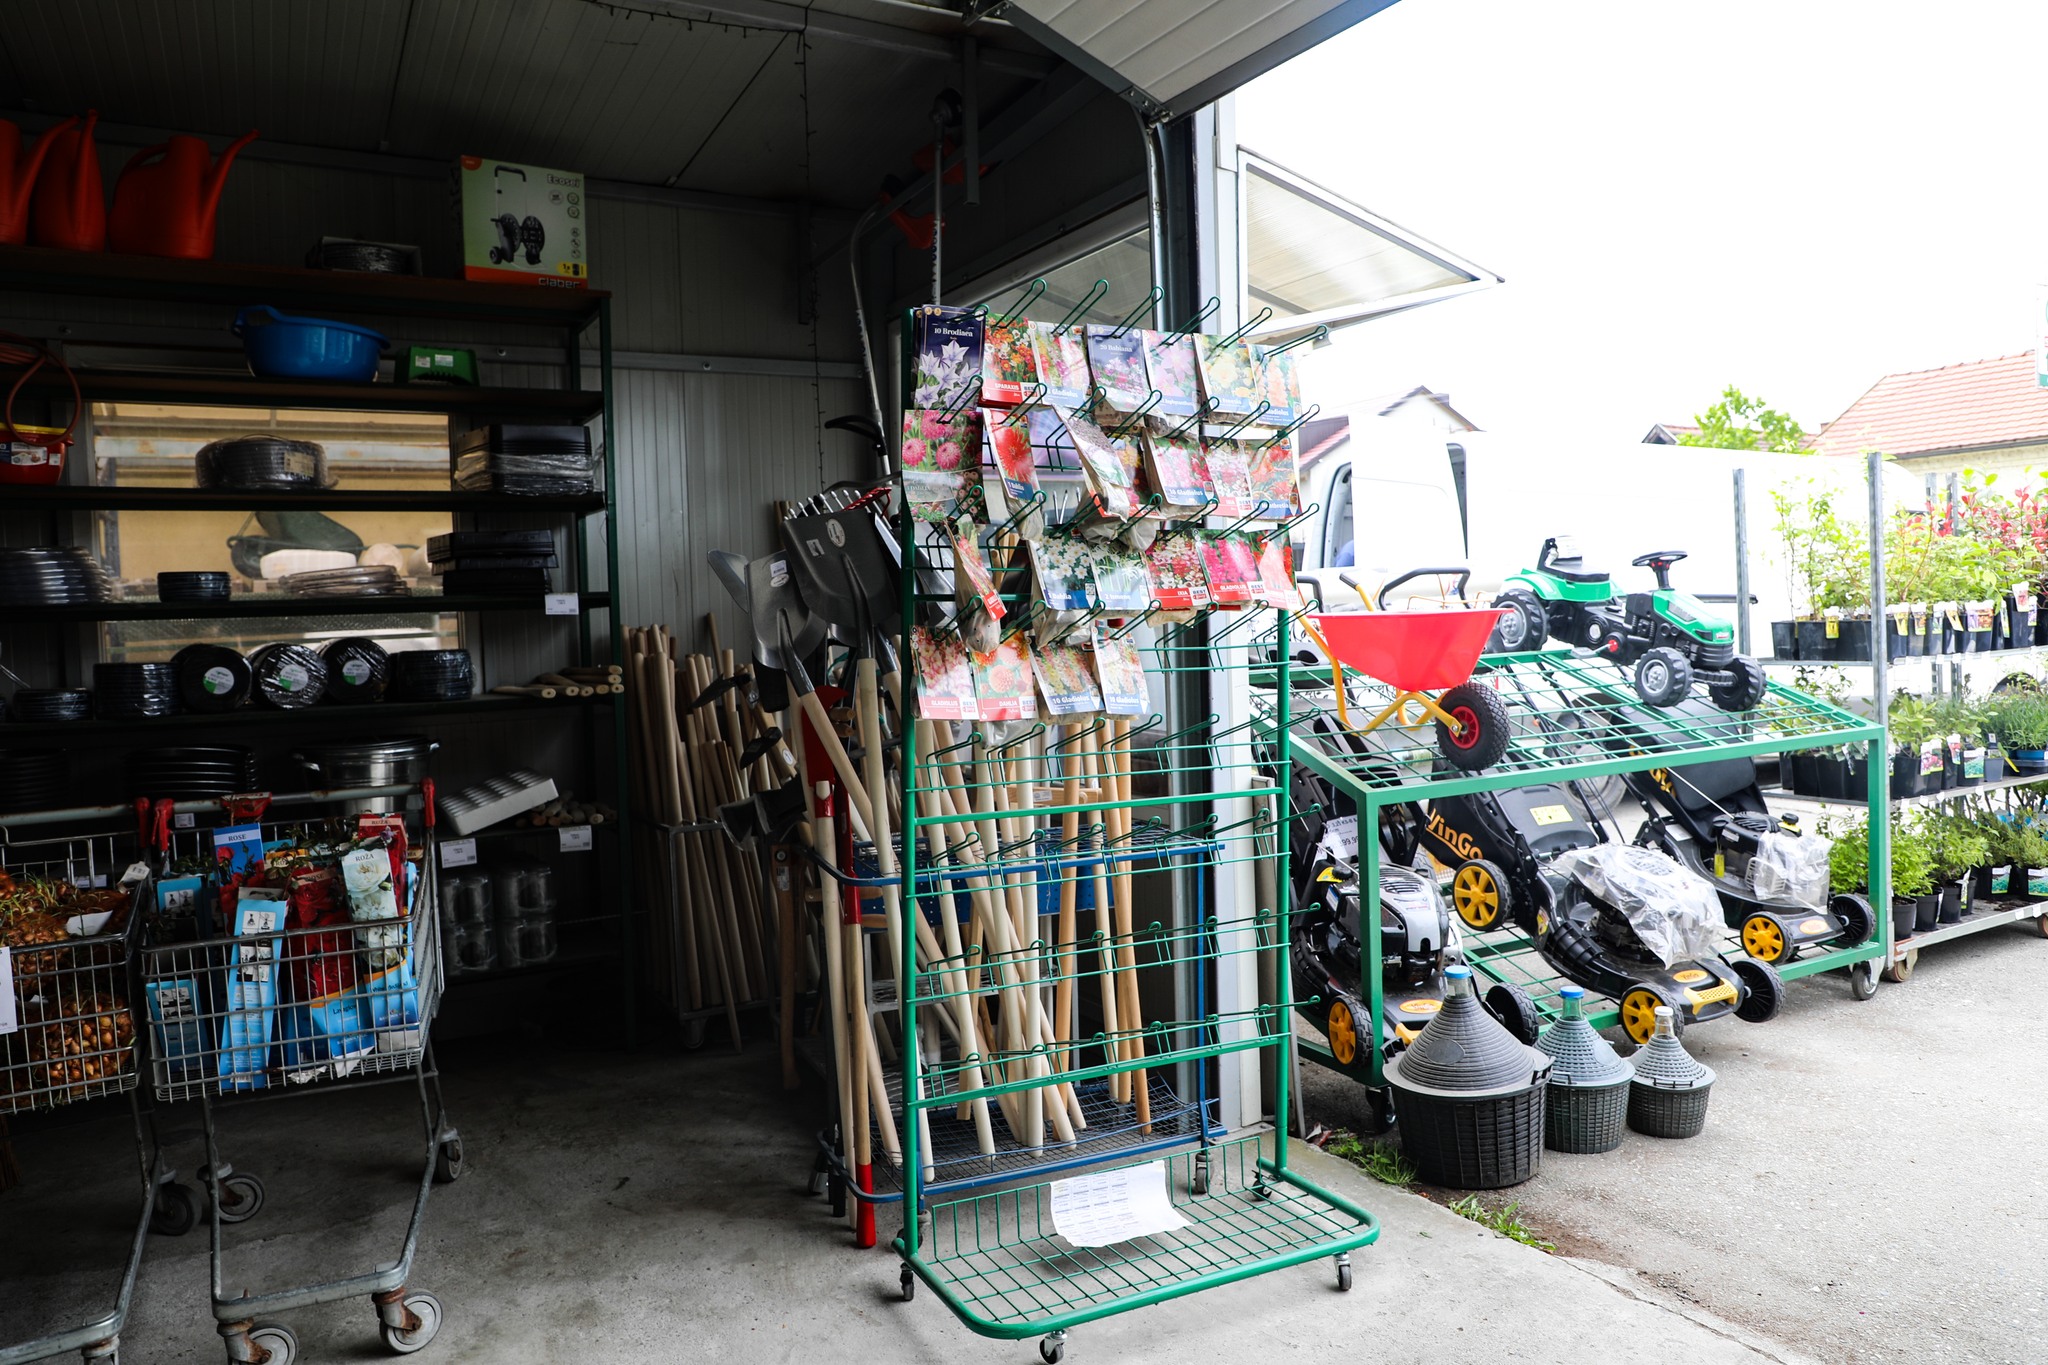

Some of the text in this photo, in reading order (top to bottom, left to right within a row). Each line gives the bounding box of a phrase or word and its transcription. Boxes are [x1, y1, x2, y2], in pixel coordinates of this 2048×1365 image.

[538, 277, 581, 289] claber
[934, 327, 973, 337] 10 Brodiaea
[1108, 344, 1133, 352] Babiana
[994, 382, 1019, 390] SPARAXIS
[1176, 488, 1203, 496] Gladiolus
[1052, 592, 1072, 600] Dahlia
[1061, 695, 1090, 703] Gladiolus
[1116, 696, 1139, 704] Gladiolus
[228, 833, 247, 842] ROSE
[355, 853, 375, 862] ROŽA
